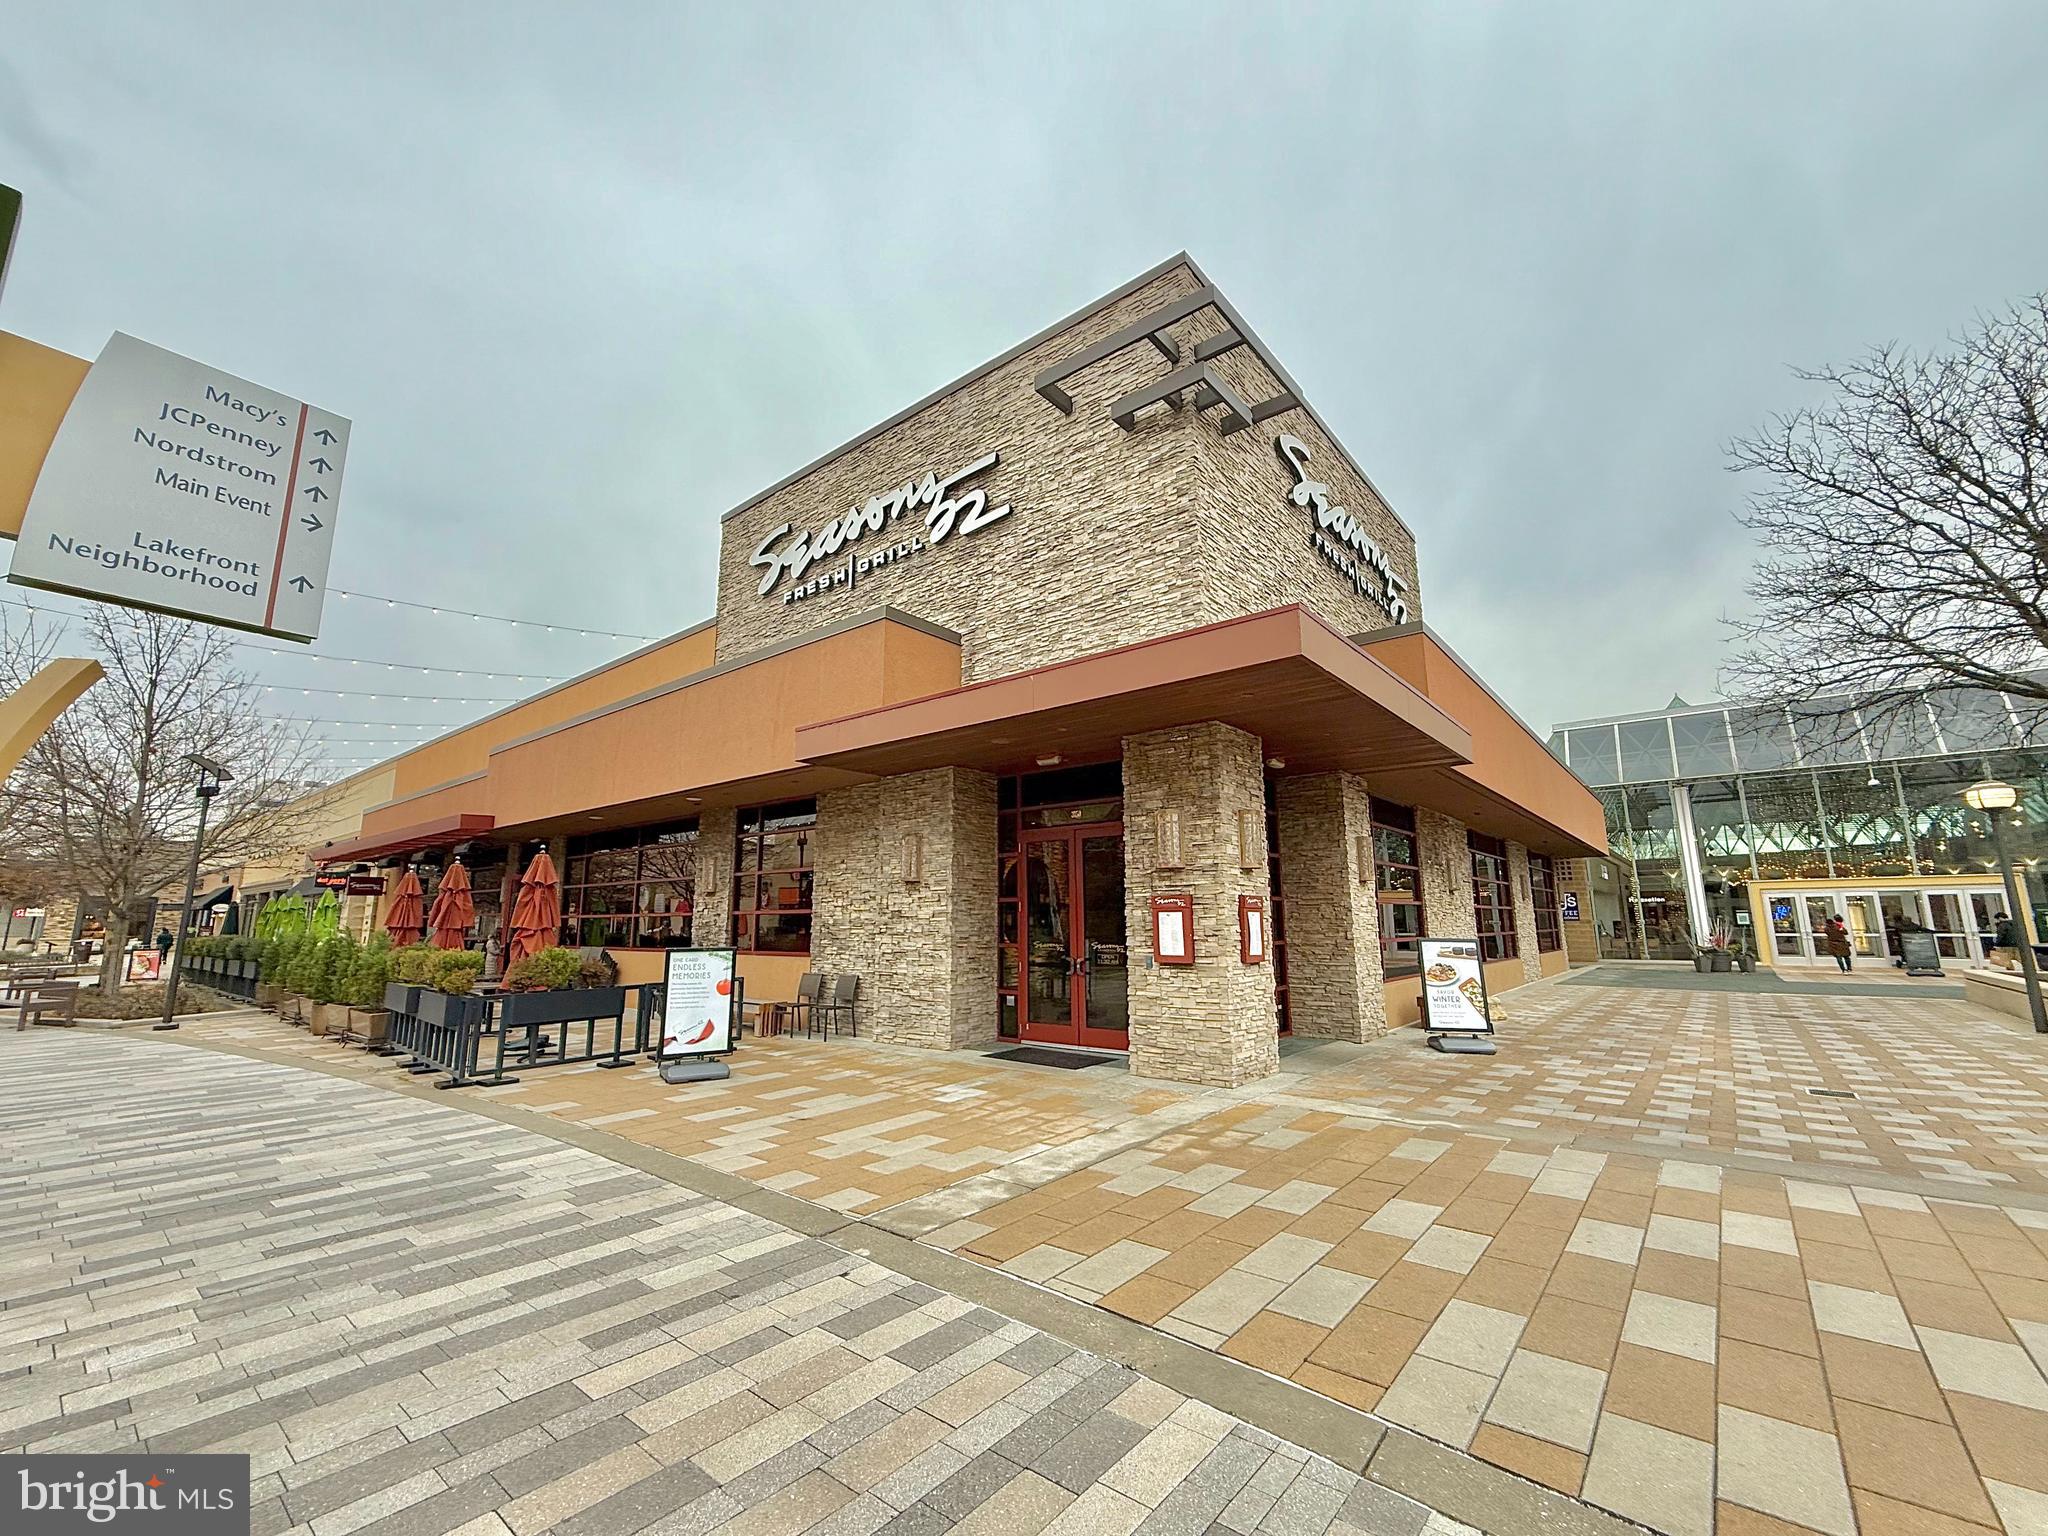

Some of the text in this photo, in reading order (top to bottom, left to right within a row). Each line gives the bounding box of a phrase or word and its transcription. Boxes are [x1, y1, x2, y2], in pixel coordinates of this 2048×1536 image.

[159, 402, 283, 457] JCPenney
[205, 385, 288, 427] Macy's
[133, 427, 277, 485] Nordstrom
[155, 467, 272, 517] Main Event
[750, 451, 1013, 596] Seasons 52
[48, 533, 259, 597] Neighborhood
[133, 531, 261, 577] Lakefront
[783, 537, 925, 604] FRESH GRILL
[671, 971, 712, 980] MEMORIES
[672, 963, 706, 971] ENDLESS
[1432, 995, 1461, 1003] WINTER
